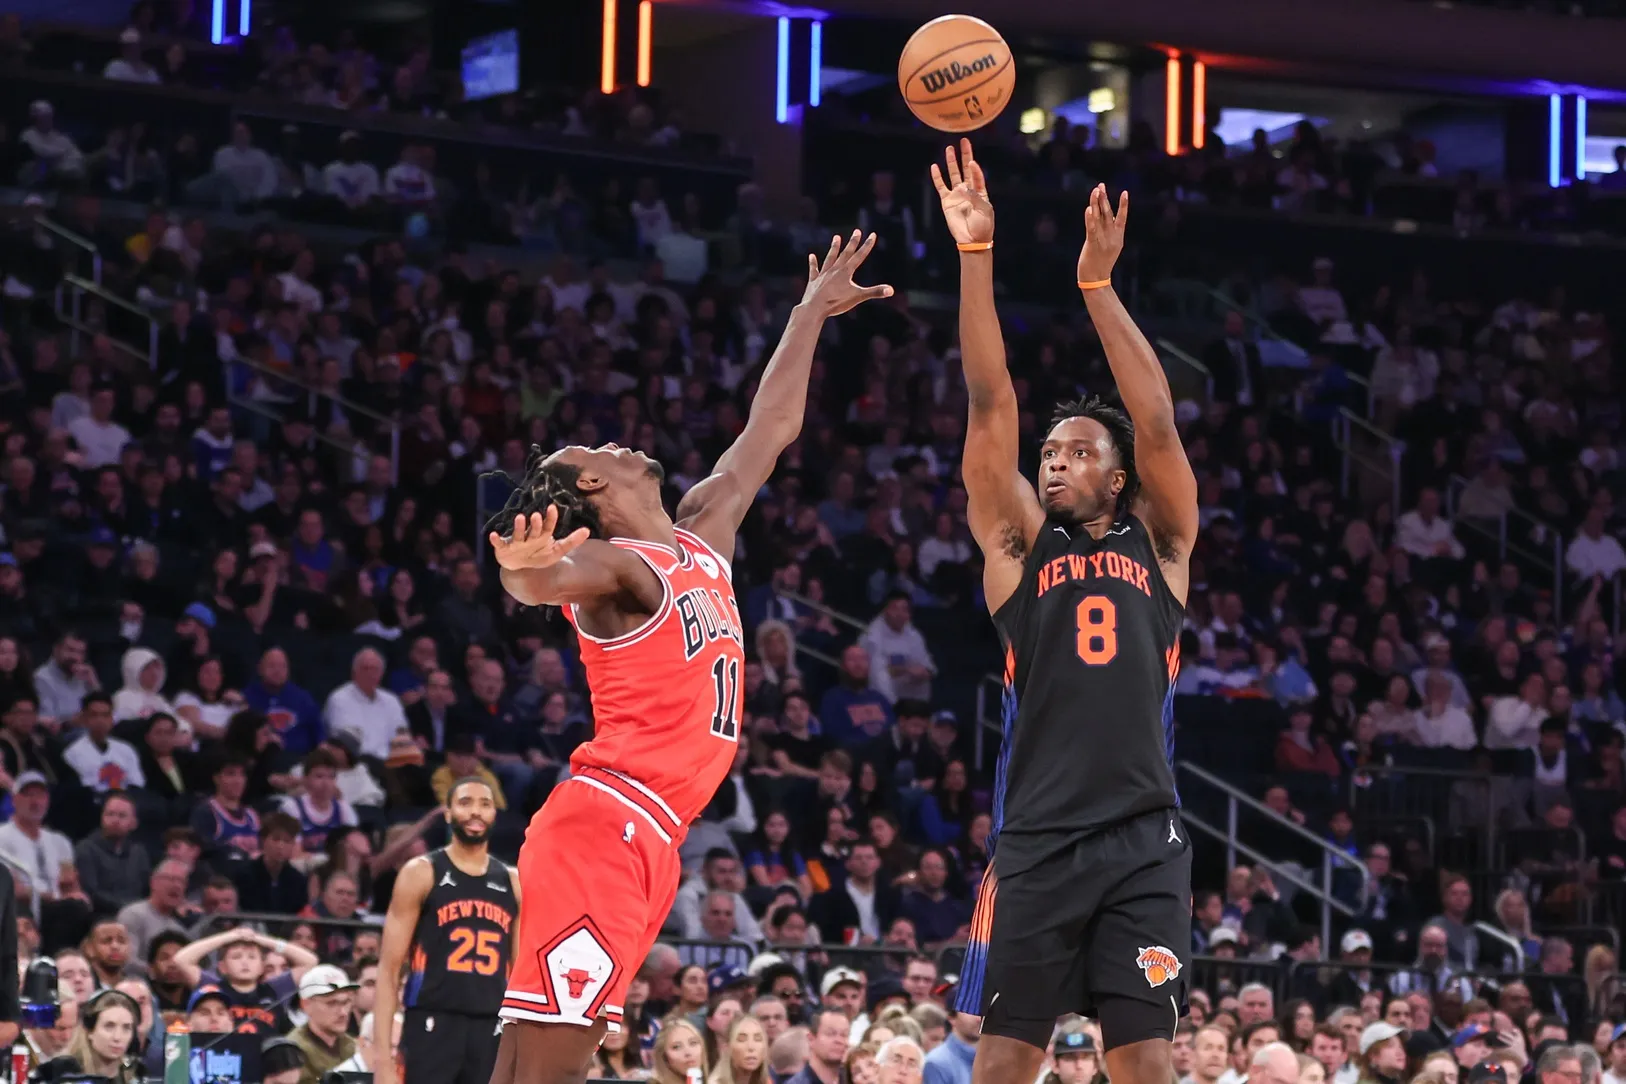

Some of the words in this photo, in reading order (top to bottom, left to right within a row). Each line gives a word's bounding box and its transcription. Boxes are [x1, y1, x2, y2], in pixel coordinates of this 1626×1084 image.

[920, 54, 997, 93] Wilson
[1037, 554, 1087, 598] NEW
[1089, 551, 1152, 598] YORK
[1076, 595, 1118, 666] 8
[710, 653, 739, 742] 11
[437, 900, 474, 927] NEW
[473, 899, 512, 934] YORK
[447, 927, 501, 976] 25
[1139, 948, 1178, 977] KNICKS
